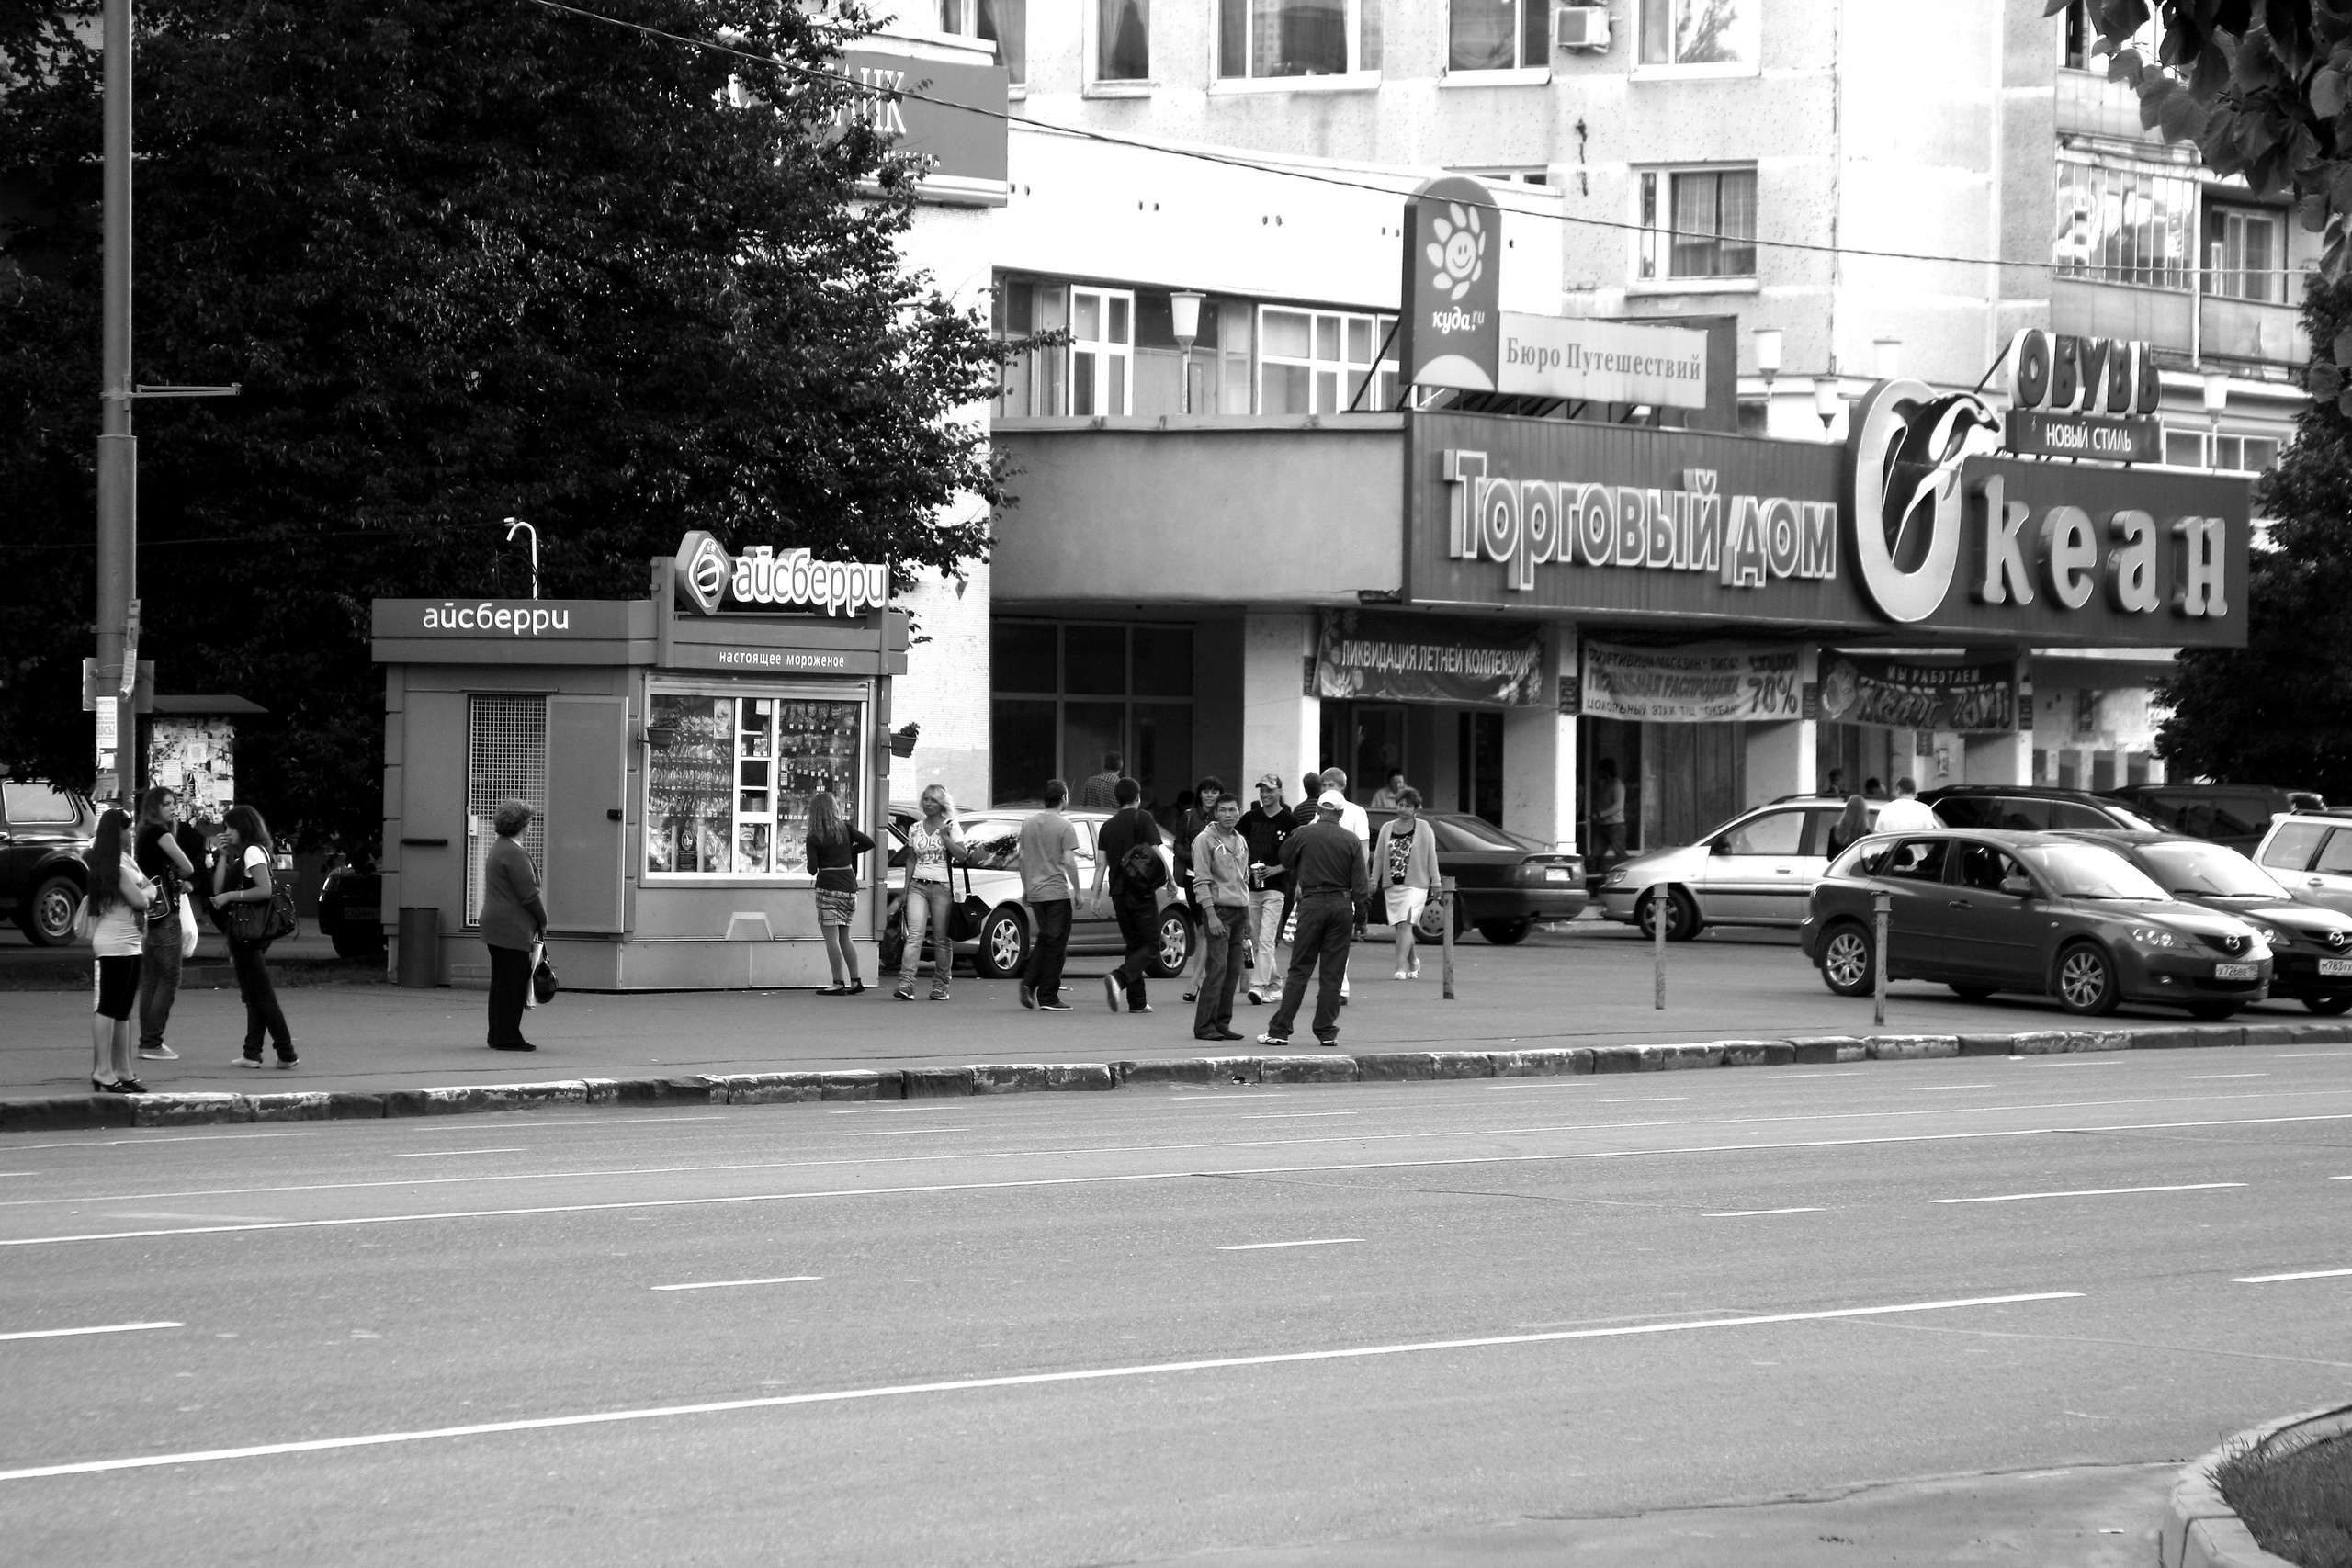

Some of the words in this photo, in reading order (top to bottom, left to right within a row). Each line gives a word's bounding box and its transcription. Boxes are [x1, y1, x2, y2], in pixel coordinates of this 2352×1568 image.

[1506, 336, 1561, 374] Бюро
[1566, 342, 1702, 380] Путешествий
[2009, 327, 2162, 415] ОБУВЬ
[2046, 421, 2088, 449] НОВЫЙ
[2094, 426, 2132, 452] СТИЛЬ
[1845, 378, 2229, 624] Океан
[732, 545, 888, 618] айсберри
[423, 603, 570, 636] айсберри
[719, 650, 781, 665] настоящее
[786, 652, 844, 667] мороженое
[1341, 640, 1417, 673] ЛИКВИДАЦИЯ
[1418, 642, 1463, 672] ЛЕТНЕЙ
[1912, 668, 1980, 685] РАБОТАЕМ
[1587, 698, 1646, 716] ЦОКОЛЬНЫЙ
[1748, 674, 1798, 715] 70%
